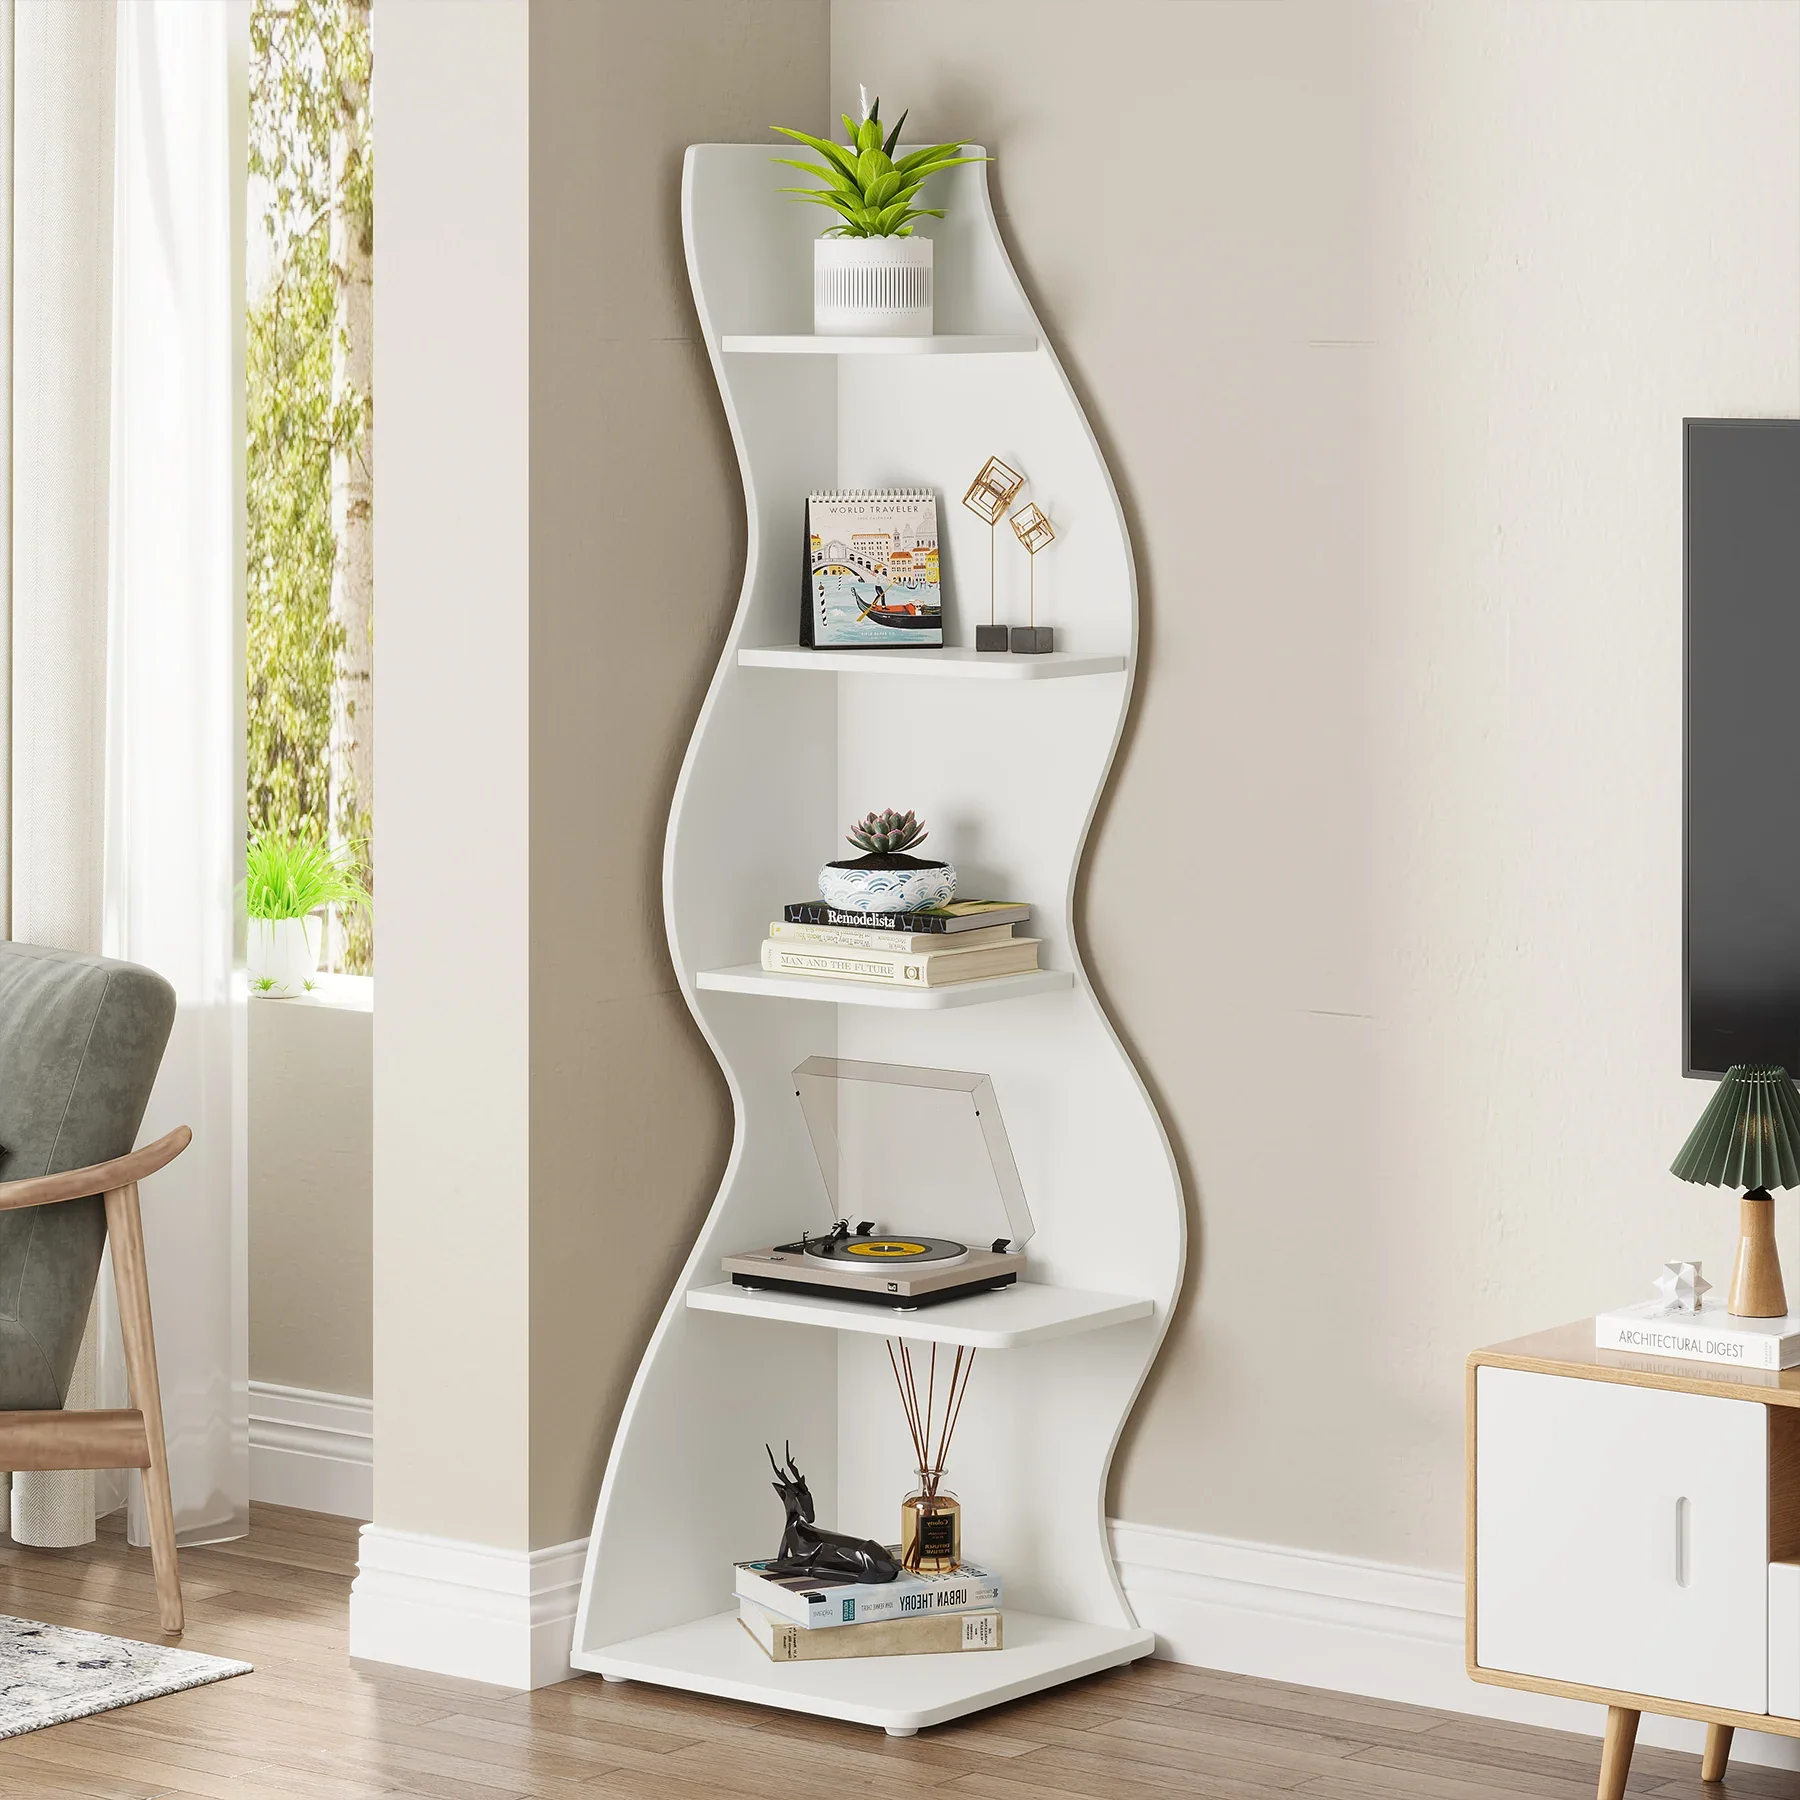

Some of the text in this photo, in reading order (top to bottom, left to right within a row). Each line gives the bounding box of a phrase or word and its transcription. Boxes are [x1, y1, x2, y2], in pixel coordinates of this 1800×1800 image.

[829, 505, 919, 514] WORLD TRAVELER
[827, 909, 896, 928] Remodelista
[822, 935, 838, 944] Don't
[838, 935, 853, 946] They
[853, 938, 871, 948] What
[781, 956, 894, 975] MAN AND THE FUTURE
[1618, 1330, 1745, 1358] ARCHITECTURAL DIGEST
